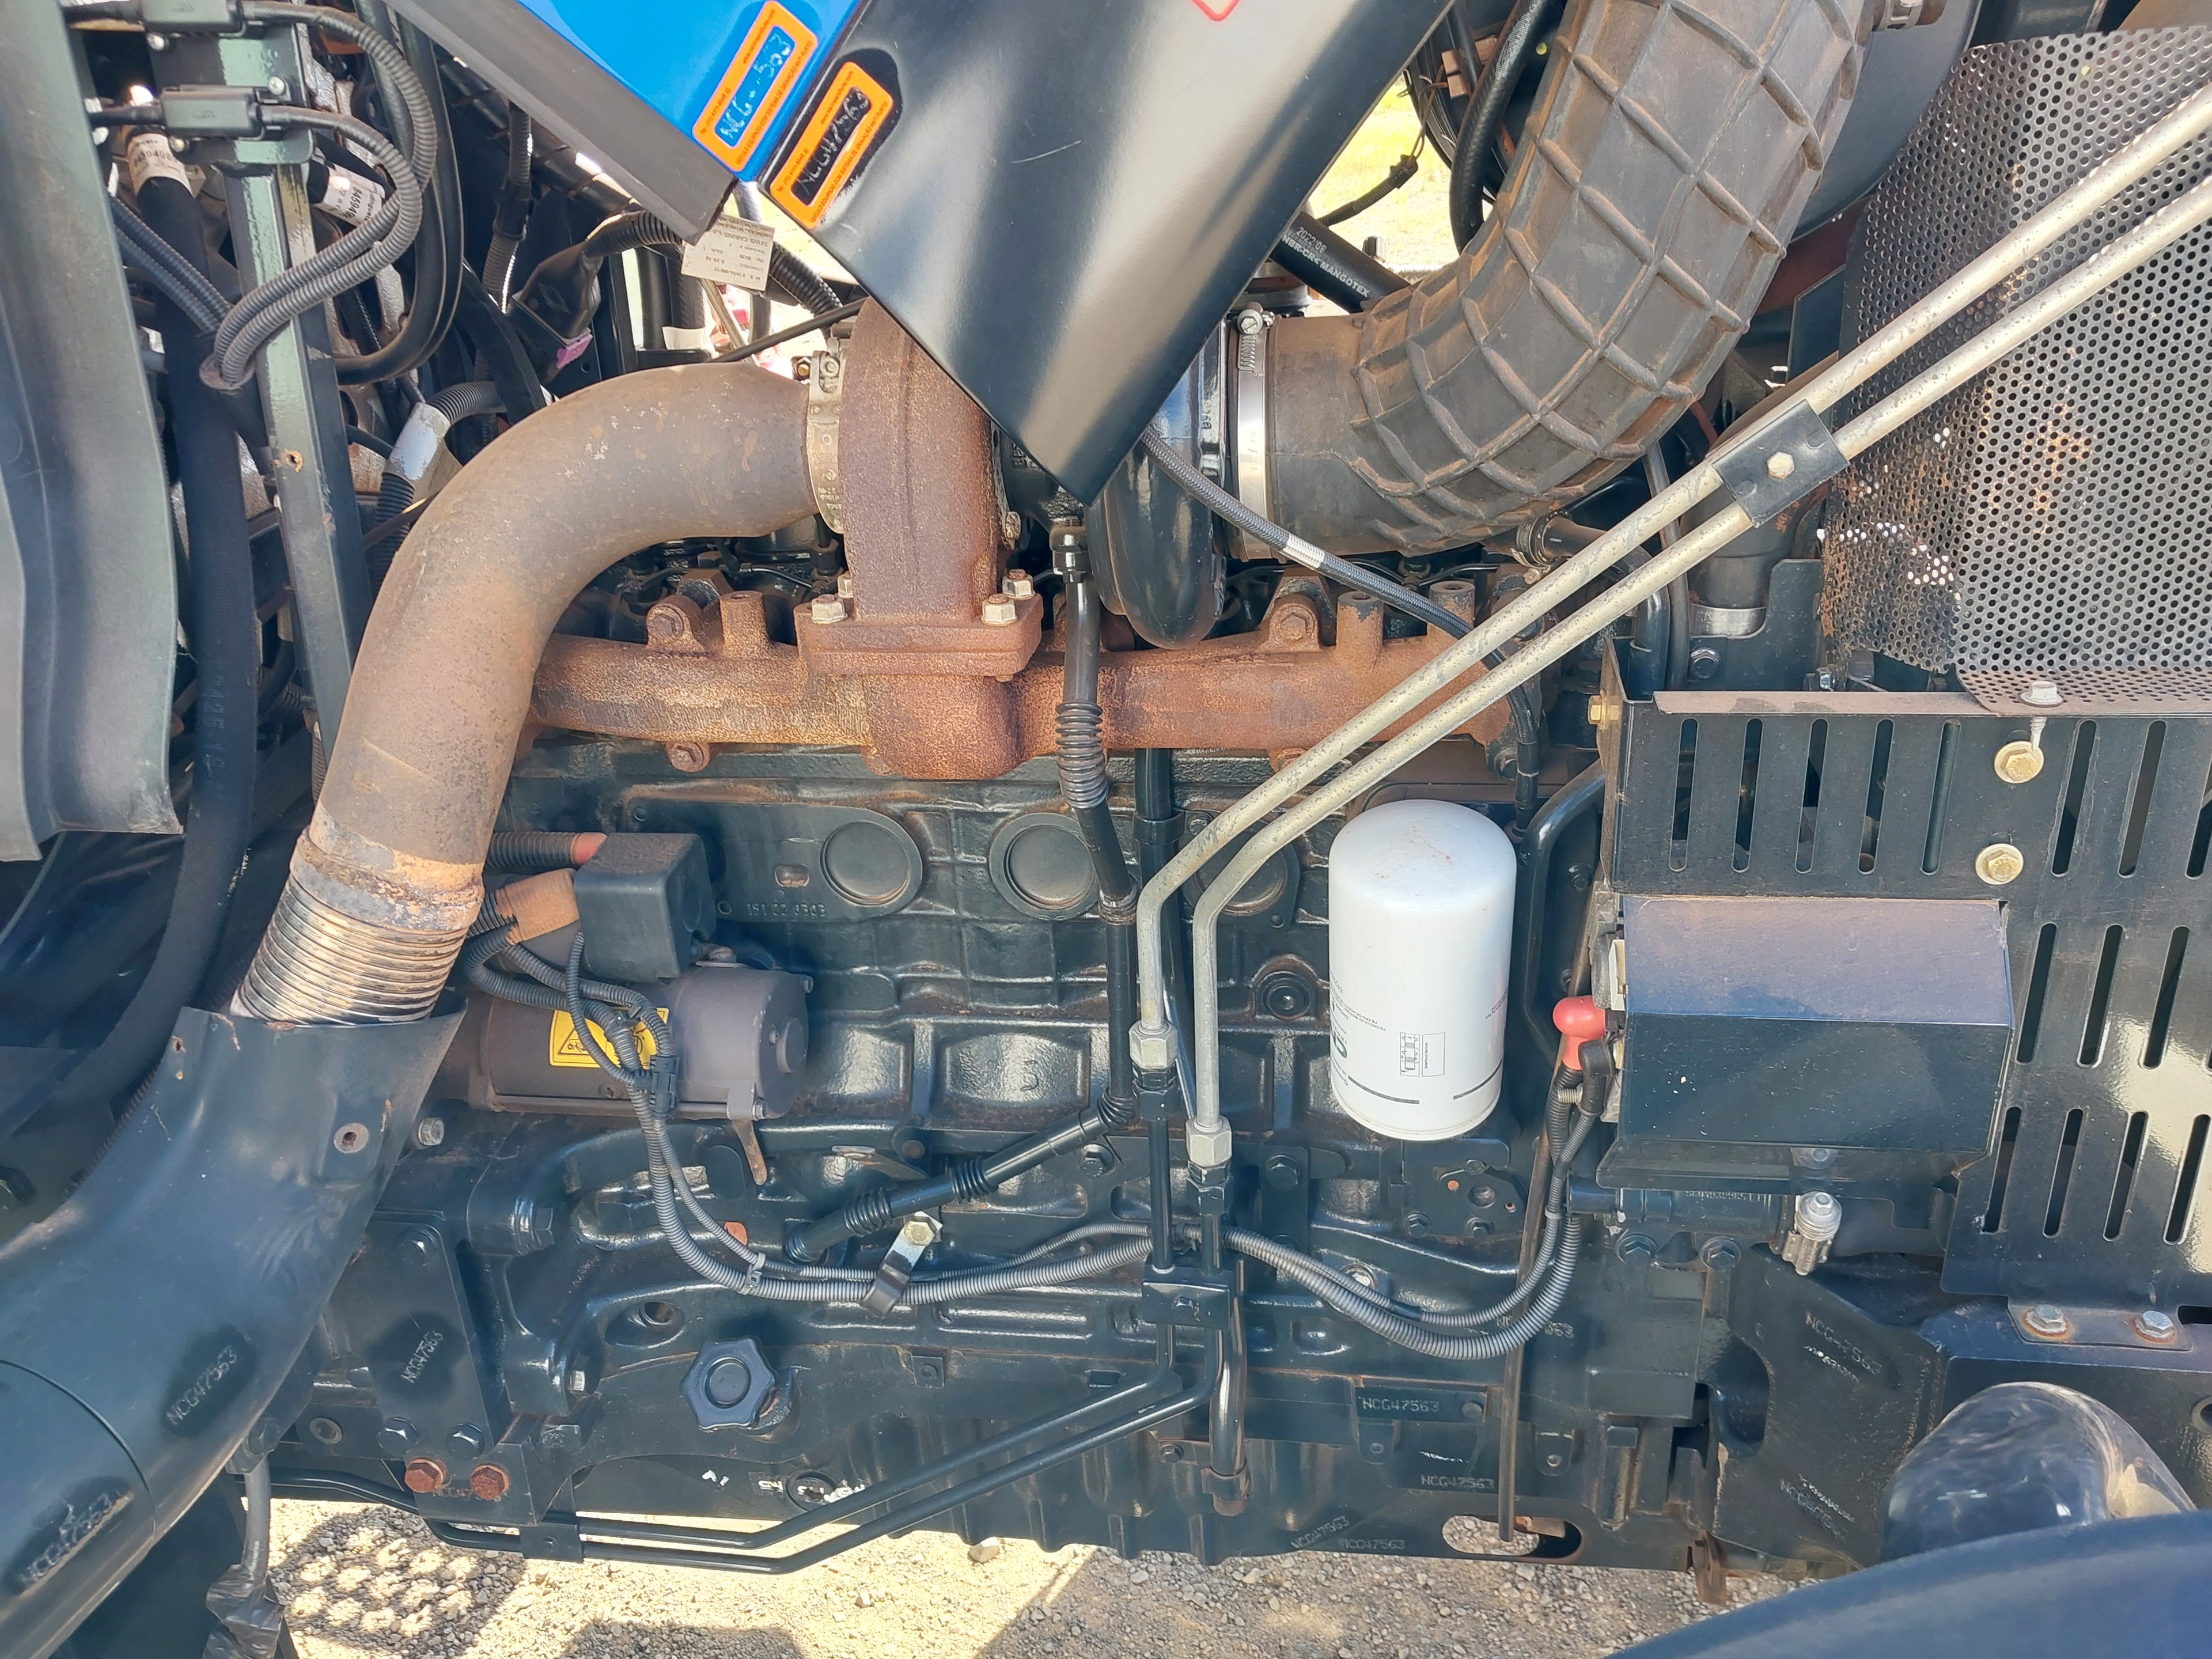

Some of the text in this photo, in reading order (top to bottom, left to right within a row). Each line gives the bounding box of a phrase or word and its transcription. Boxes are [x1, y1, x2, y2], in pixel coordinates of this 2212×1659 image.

[1319, 262, 1370, 298] MANGOTEX
[166, 1345, 238, 1426] NCG47563
[1362, 1396, 1440, 1412] NCG47563
[1421, 1474, 1495, 1490] NCG47563
[1290, 1514, 1350, 1550] NCG47563
